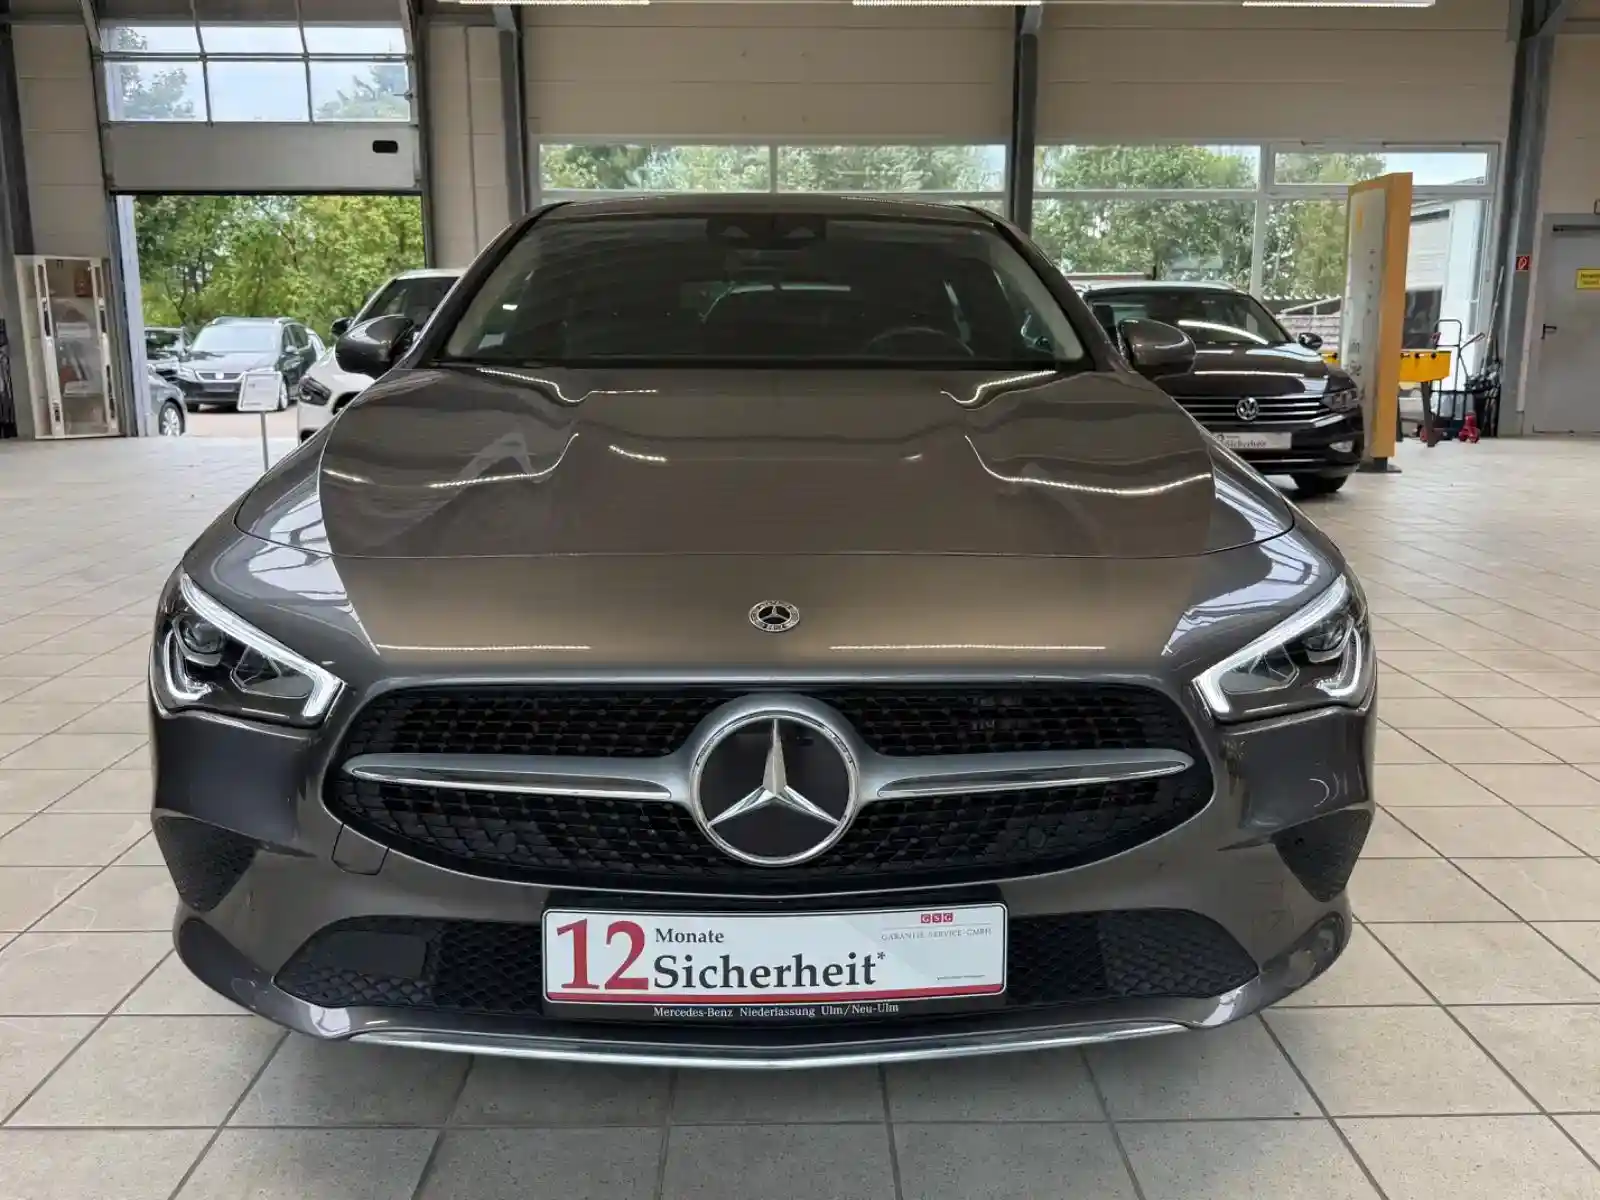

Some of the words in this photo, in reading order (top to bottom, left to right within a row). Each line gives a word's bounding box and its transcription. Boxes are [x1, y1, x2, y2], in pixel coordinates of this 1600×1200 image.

[921, 912, 953, 923] GSG
[655, 928, 724, 943] Monate
[557, 919, 648, 990] 12
[653, 1006, 734, 1017] Mercedes-Benz
[821, 1002, 899, 1016] Ulm/Neu-Ulm
